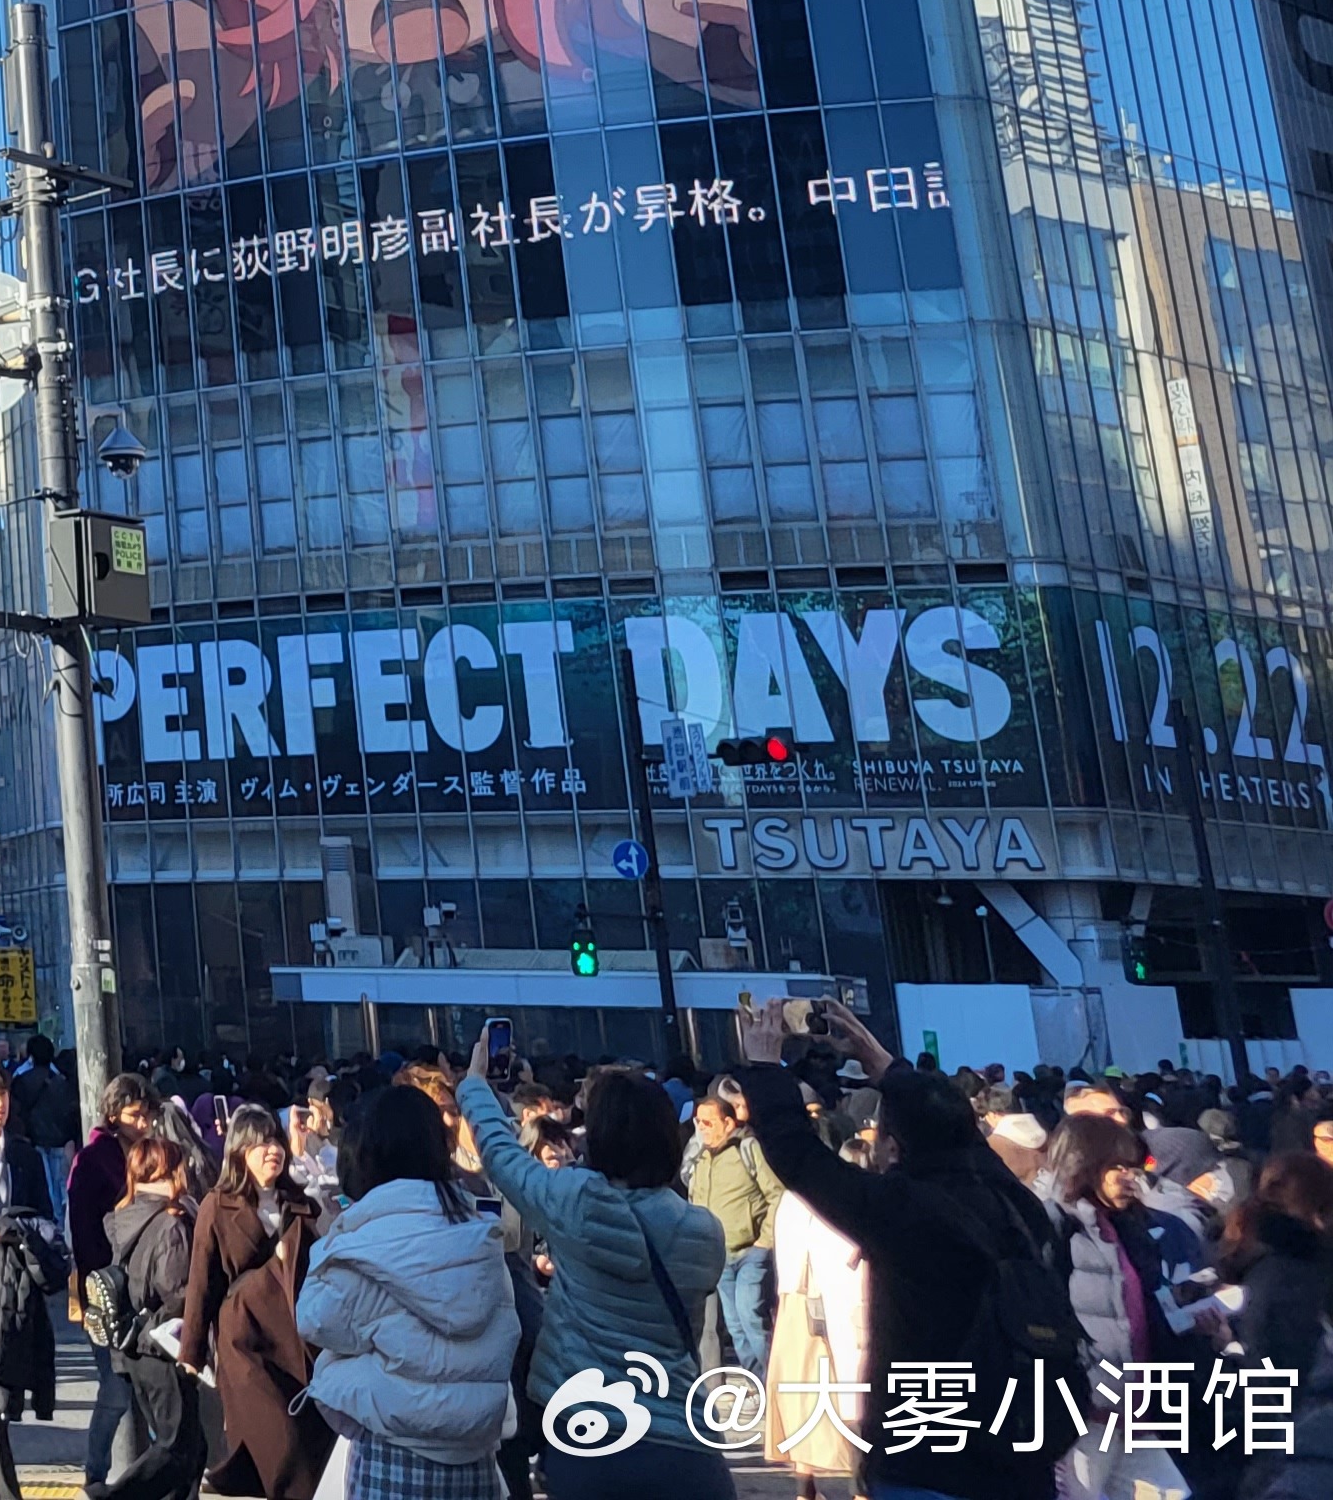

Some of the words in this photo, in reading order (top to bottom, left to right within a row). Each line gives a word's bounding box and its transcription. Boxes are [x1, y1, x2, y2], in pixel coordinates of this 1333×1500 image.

[114, 530, 141, 542] CCTV
[115, 549, 142, 560] POLICE
[92, 619, 574, 766] PERFECT
[623, 605, 1013, 747] DAYS
[1095, 617, 1325, 771] 12.22
[852, 759, 933, 775] SHIBUYA
[941, 758, 1025, 775] TSUTAYA
[174, 778, 218, 805] 主演
[853, 776, 942, 792] RENEWAL.
[948, 779, 967, 788] 2024
[1144, 767, 1174, 796] IN
[1201, 766, 1314, 812] HEATERS
[703, 817, 1046, 871] TSUTAYA
